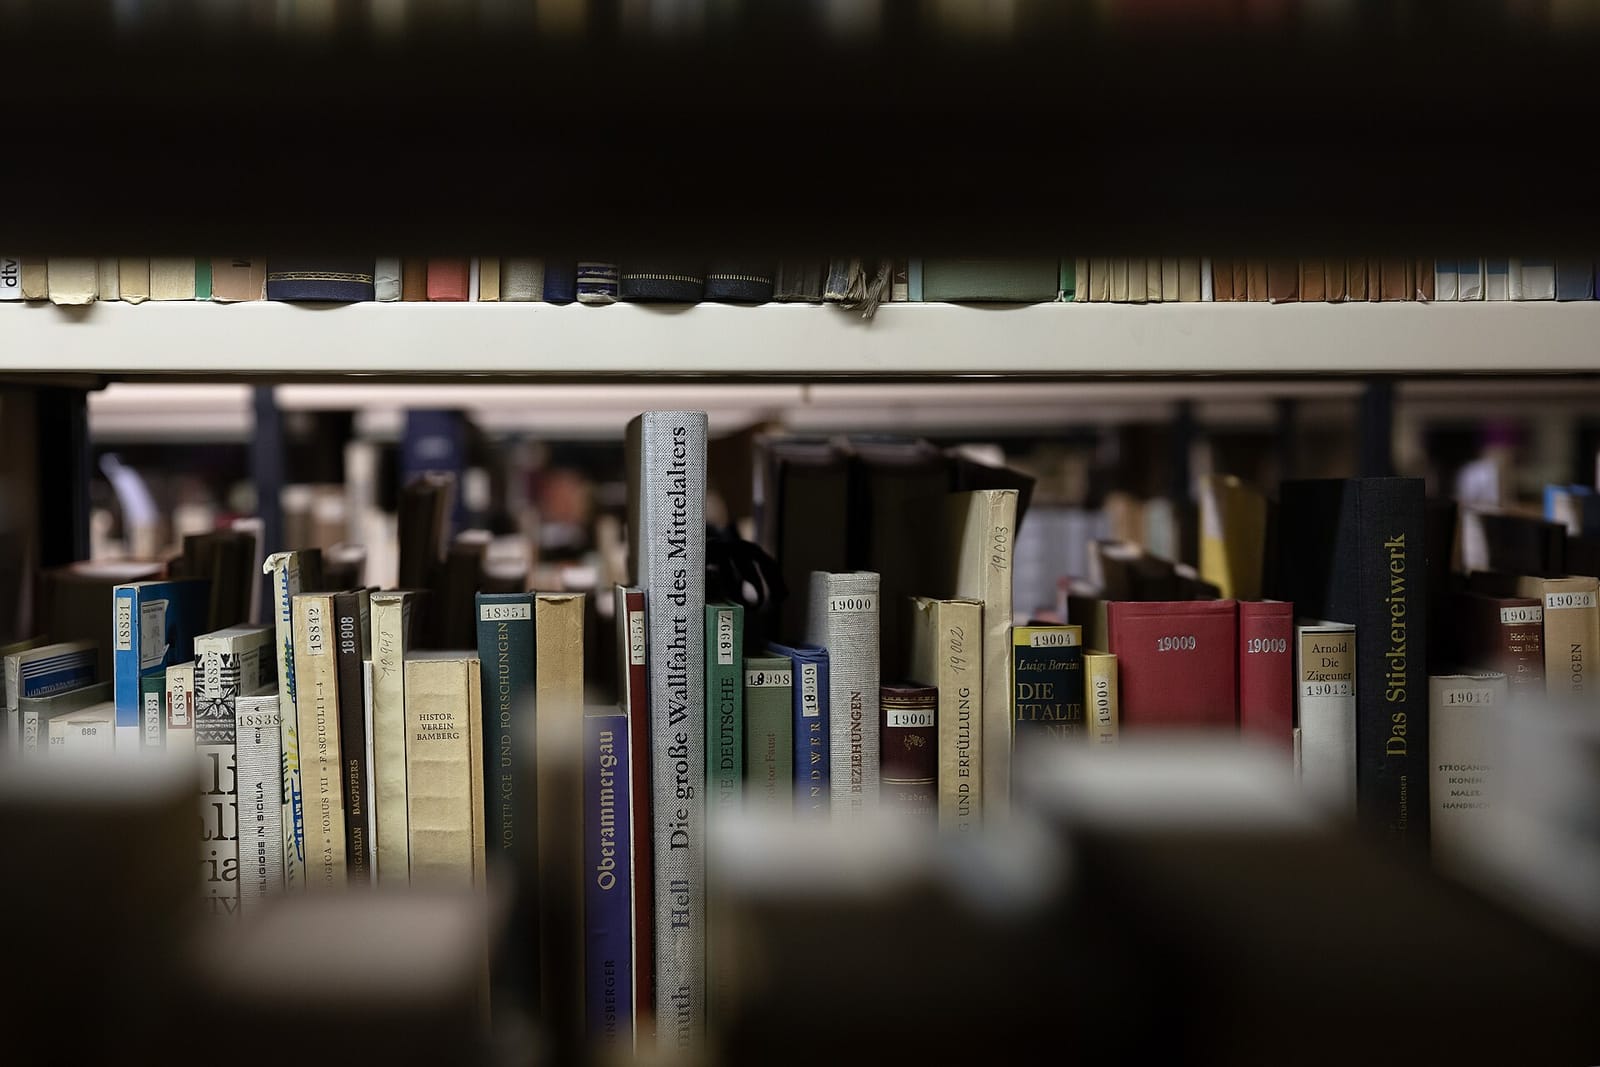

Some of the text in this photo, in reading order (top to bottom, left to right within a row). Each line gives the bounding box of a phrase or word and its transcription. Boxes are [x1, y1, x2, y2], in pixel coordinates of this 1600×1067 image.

[5, 258, 17, 287] dtv
[991, 526, 1009, 572] 19003
[486, 607, 527, 619] 18951
[831, 599, 871, 611] 19000
[1503, 610, 1542, 622] 19015
[1548, 595, 1590, 608] 19020
[119, 604, 131, 647] 18831
[309, 607, 321, 650] 18842
[666, 426, 694, 851] Die große Wallfahrt des Mittelalters
[720, 615, 732, 658] 18997
[1034, 633, 1071, 646] 19004
[950, 626, 964, 675] 19002
[1157, 637, 1196, 652] 19009
[1248, 639, 1287, 653] 19009
[1312, 643, 1347, 653] Arnold
[1384, 532, 1407, 757] Das Stickereiwerk
[208, 650, 220, 693] 18837
[499, 622, 511, 728] FORSCHUNGEN
[1018, 659, 1047, 673] Luigi
[1306, 671, 1352, 683] Zigeuner
[1321, 658, 1339, 668] Die
[174, 677, 185, 719] 18834
[804, 668, 817, 711] 18999
[1018, 684, 1054, 700] DIE
[1098, 680, 1110, 725] 19006
[1307, 684, 1348, 696] 19012
[82, 727, 97, 736] 689
[239, 714, 280, 727] 18838
[419, 713, 455, 721] HISTOR.
[421, 723, 454, 731] VEREIN
[721, 677, 734, 771] DEUTSCHE
[893, 714, 932, 726] 19001
[957, 687, 970, 777] ERFÜLLUNG
[26, 716, 38, 752] 8828
[317, 703, 328, 767] FASCICULI
[417, 732, 460, 741] BAMBERG
[765, 733, 775, 762] Faust
[850, 691, 862, 795] BEZIEHUNGEN
[502, 735, 512, 767] UND
[321, 777, 329, 792] VII
[959, 783, 970, 816] UND
[255, 781, 264, 823] SICILIA
[322, 799, 330, 834] TOMUS
[351, 759, 362, 872] NGARIAN BAGPIPERS
[597, 730, 617, 891] Oberammergau
[256, 826, 265, 837] IN
[325, 847, 333, 881] OGICA
[671, 879, 690, 931] Hell
